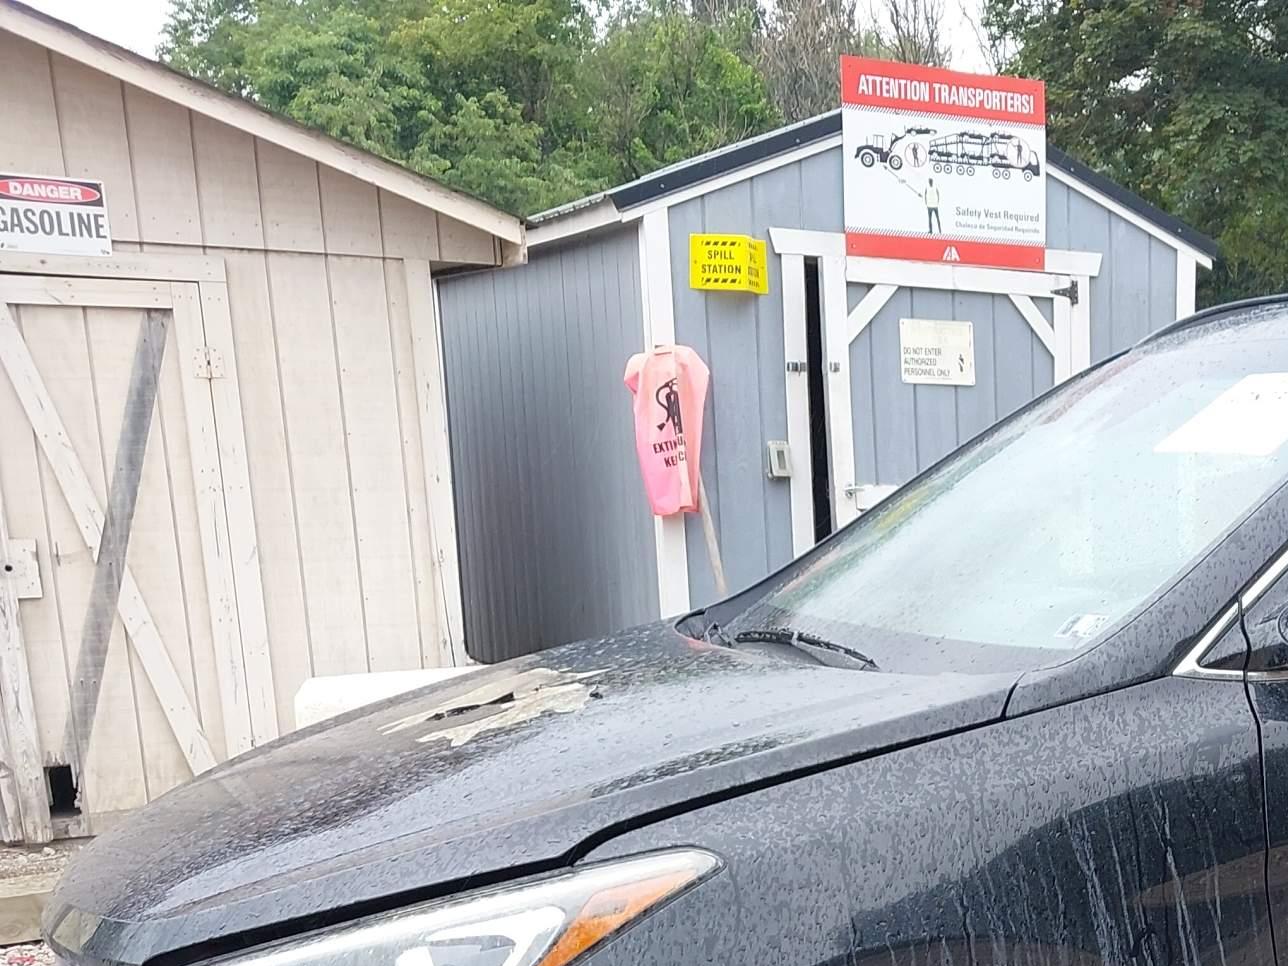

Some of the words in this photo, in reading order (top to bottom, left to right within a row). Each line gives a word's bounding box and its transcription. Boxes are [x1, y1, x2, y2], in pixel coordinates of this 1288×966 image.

[858, 74, 929, 103] ATTENTION
[933, 83, 1034, 114] TRANSPORTERS!
[8, 181, 82, 201] DANGER
[955, 206, 981, 220] Safety
[984, 208, 1001, 219] Vest
[1003, 210, 1040, 224] Required
[0, 206, 107, 239] GASOLINE
[707, 249, 735, 260] SPILL
[701, 264, 742, 275] STATION
[903, 346, 911, 356] DO
[912, 347, 923, 356] NOT
[925, 347, 942, 357] ENTER
[904, 357, 937, 367] AUTHORIZED
[904, 367, 936, 377] PERSONNEL
[937, 368, 951, 377] ONLY
